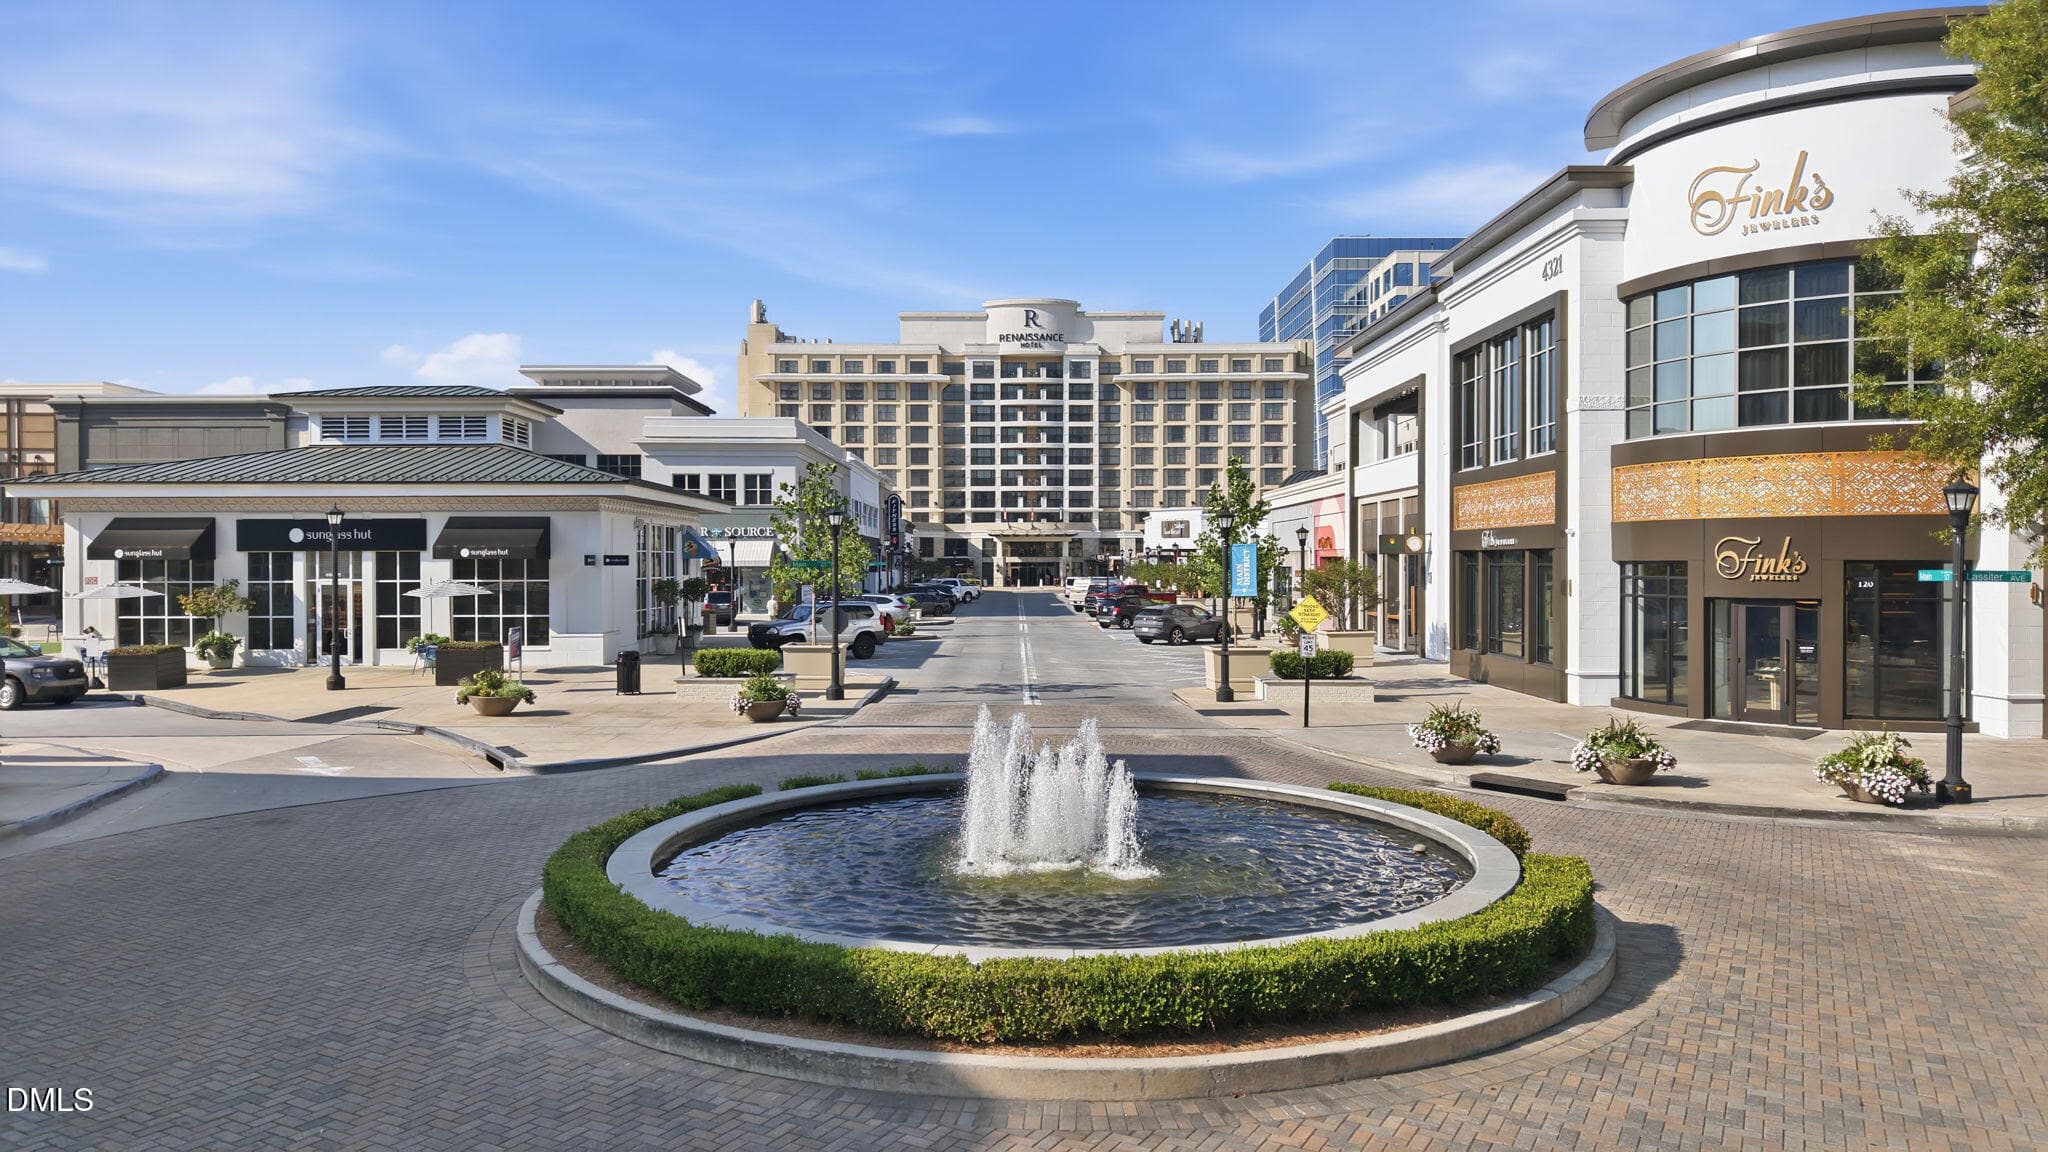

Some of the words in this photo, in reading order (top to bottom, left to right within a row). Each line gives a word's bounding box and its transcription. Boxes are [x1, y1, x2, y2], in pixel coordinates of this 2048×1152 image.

[1688, 150, 1834, 236] Fink's
[1742, 214, 1820, 236] JEWELERS
[1542, 254, 1563, 281] 4321
[1024, 309, 1041, 327] R
[999, 333, 1064, 343] RENAISSANCE
[353, 528, 373, 540] hut
[724, 526, 774, 537] SOURCE
[124, 549, 151, 558] sunglass
[151, 549, 162, 557] hut
[470, 549, 497, 557] sunglass
[1714, 536, 1809, 580] Fink's
[1236, 563, 1244, 586] MAIN
[1243, 550, 1251, 586] DISTRICT
[1750, 574, 1799, 582] JEWELERS
[1966, 571, 2003, 581] Lassiter
